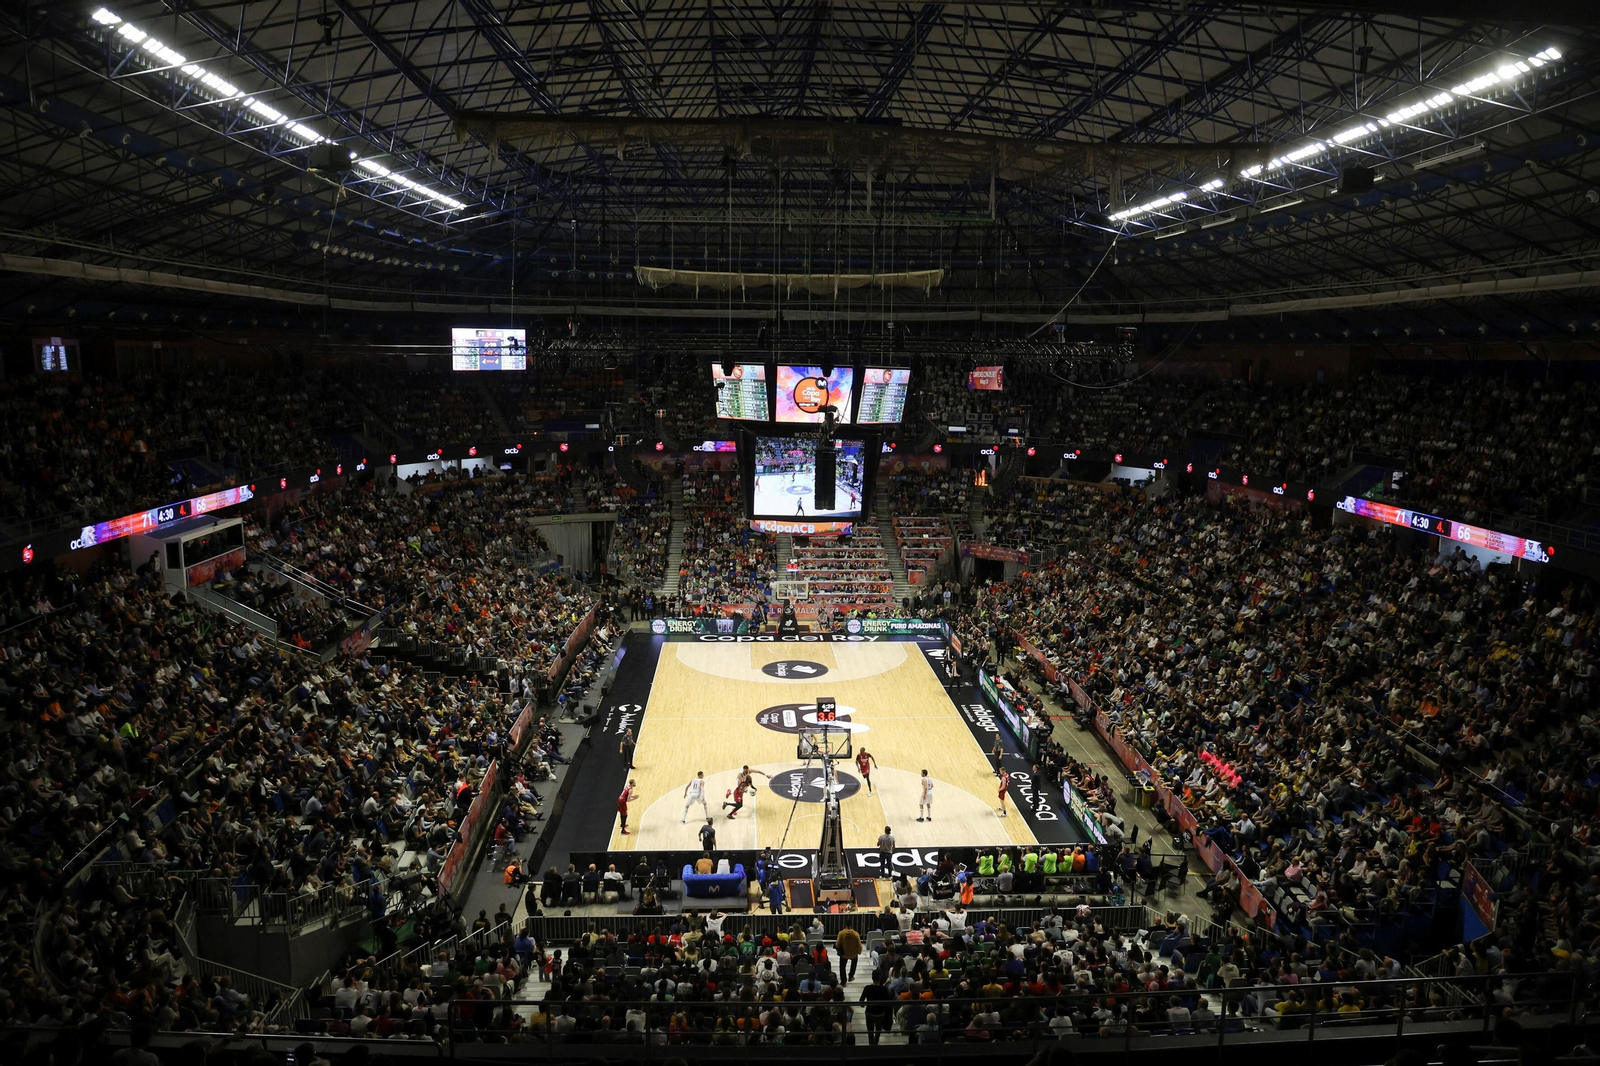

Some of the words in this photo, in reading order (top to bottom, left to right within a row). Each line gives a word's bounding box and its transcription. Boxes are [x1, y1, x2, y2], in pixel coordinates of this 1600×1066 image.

[802, 390, 820, 398] Copa
[980, 447, 995, 455] acb
[1153, 461, 1165, 469] acb
[1207, 470, 1217, 479] acb
[1273, 485, 1284, 495] acb
[196, 498, 206, 512] 66
[141, 512, 153, 528] 71
[158, 507, 174, 522] 4:30
[1395, 509, 1406, 524] 71
[760, 521, 815, 533] #CopaACB
[1411, 514, 1429, 530] 4:30
[1457, 526, 1471, 541] 66
[890, 622, 907, 630] PURO
[907, 622, 941, 630] AMAZONAS
[700, 634, 774, 643] Copa
[781, 634, 824, 642] del
[832, 634, 880, 642] Rey
[818, 712, 835, 722] 3.6
[969, 704, 1000, 732] málaga
[787, 772, 807, 797] Unicaja
